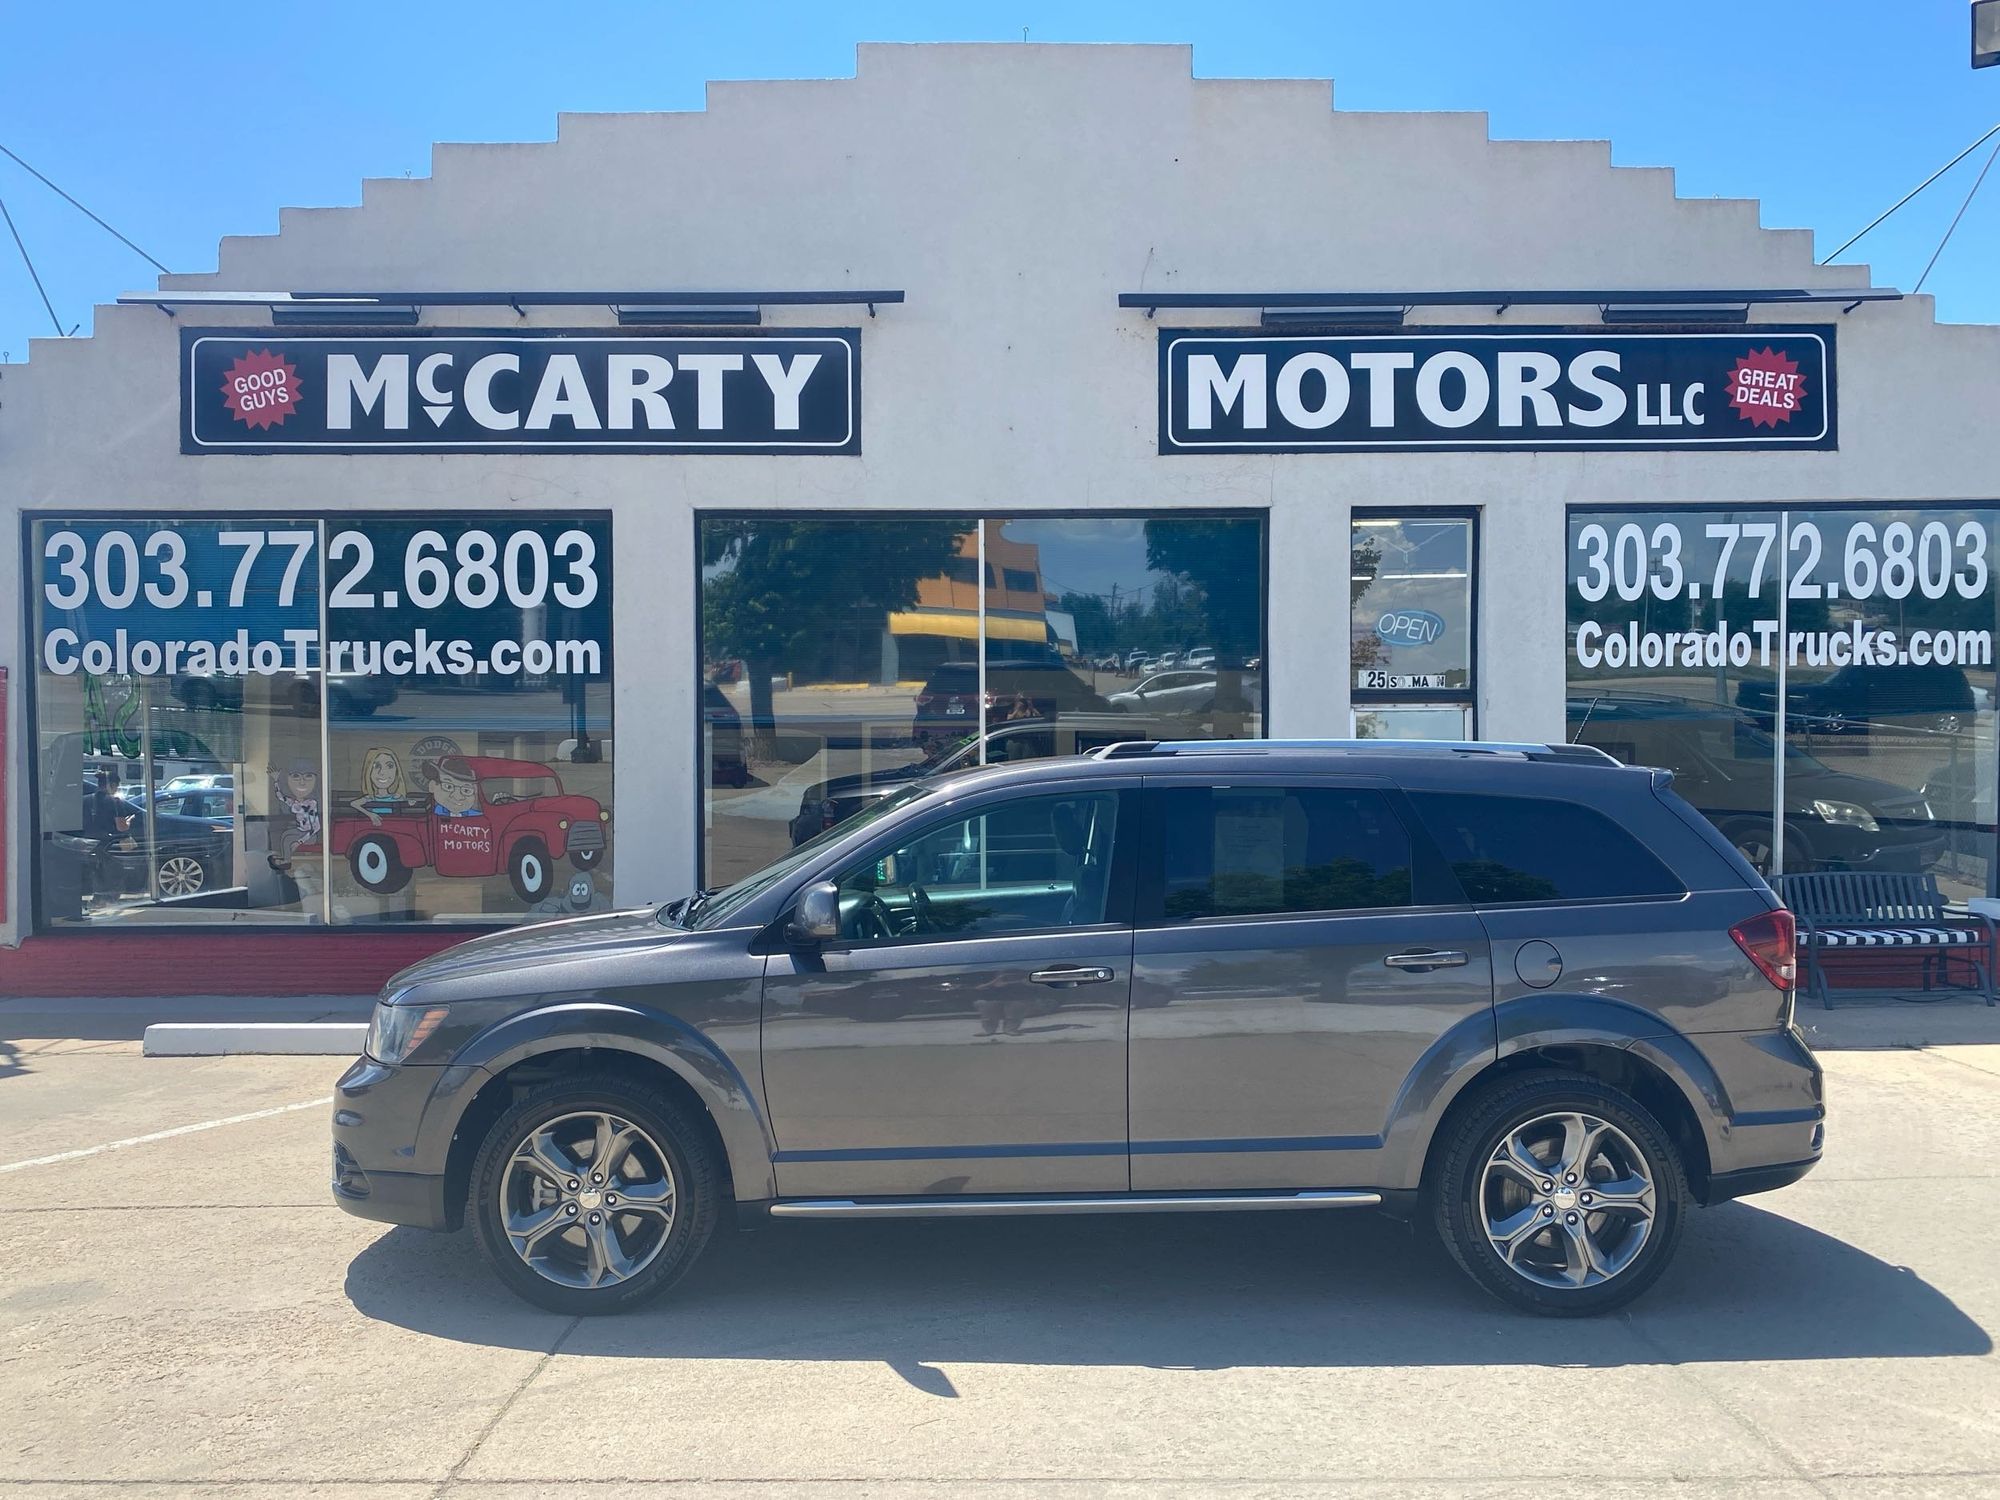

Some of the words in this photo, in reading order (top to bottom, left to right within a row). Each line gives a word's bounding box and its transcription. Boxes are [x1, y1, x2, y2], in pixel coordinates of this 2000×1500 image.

[234, 368, 287, 394] GOOD
[1187, 350, 1628, 430] MOTORS
[1637, 382, 1705, 426] LLC
[1738, 368, 1799, 391] GREAT
[240, 387, 290, 412] GUYS
[1736, 387, 1795, 409] DEALS
[44, 529, 599, 610] 303.772.6803
[1576, 521, 1989, 602] 303.772.6803
[1379, 613, 1438, 642] OPEN
[44, 627, 601, 676] ColoradoTrucks.com
[1576, 619, 1992, 668] ColoradoTrucks.com
[444, 839, 490, 853] MOTORS
